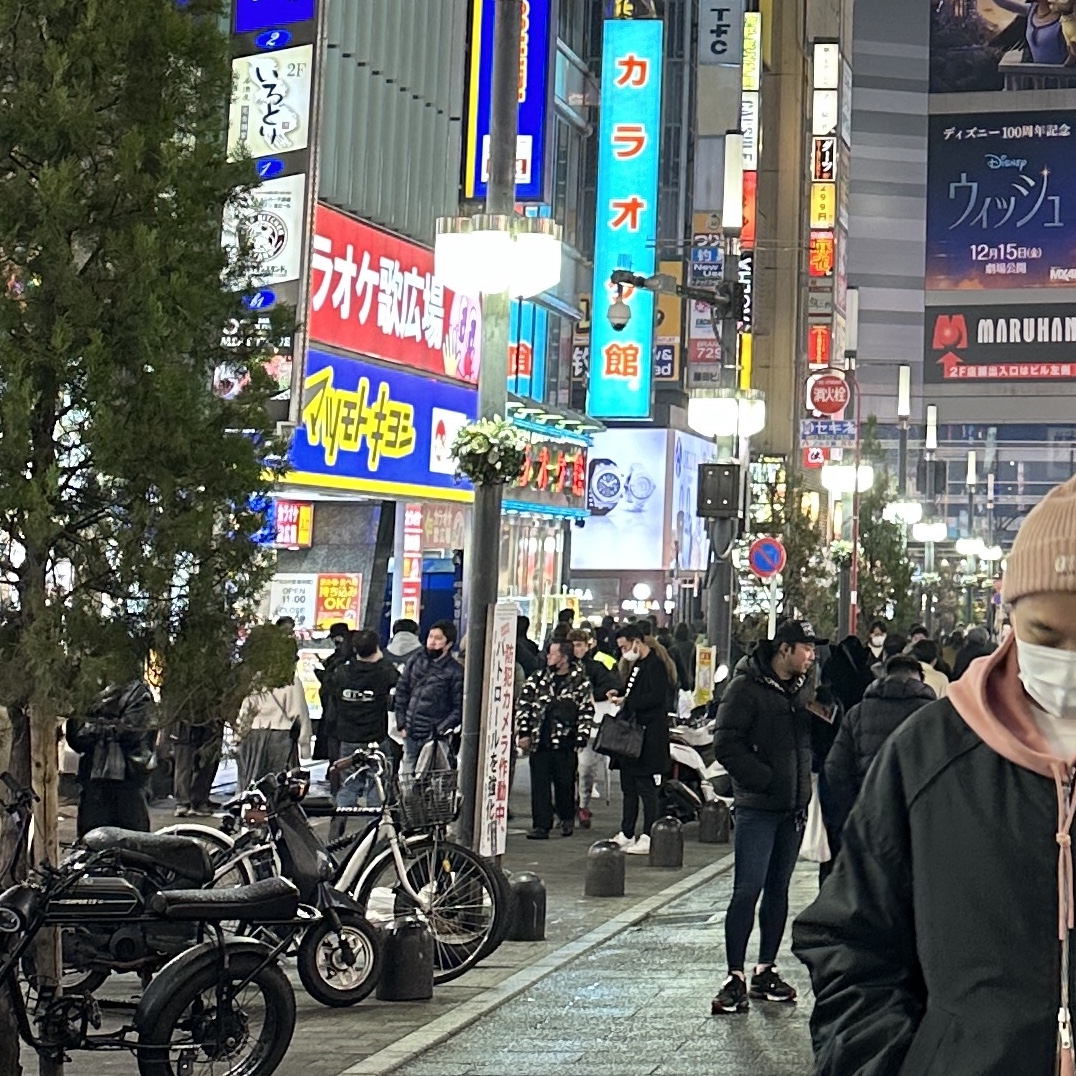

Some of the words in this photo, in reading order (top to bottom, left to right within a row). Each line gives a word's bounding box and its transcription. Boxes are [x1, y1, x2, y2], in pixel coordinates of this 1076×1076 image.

[265, 32, 280, 46] 2
[286, 63, 307, 77] 2F
[255, 67, 284, 145] いろとり
[943, 124, 1071, 141] ディズニー100周年記念
[260, 162, 271, 176] 1
[984, 154, 1028, 171] Disney
[948, 170, 1065, 230] ウィッシュ
[605, 54, 648, 377] カラオ館
[970, 244, 1043, 261] 12月15日(金)
[312, 234, 445, 350] ラオケ歌広場
[976, 317, 1076, 344] MARUHAN
[813, 386, 846, 403] 消火栓
[302, 366, 416, 472] マツモトキヨシ
